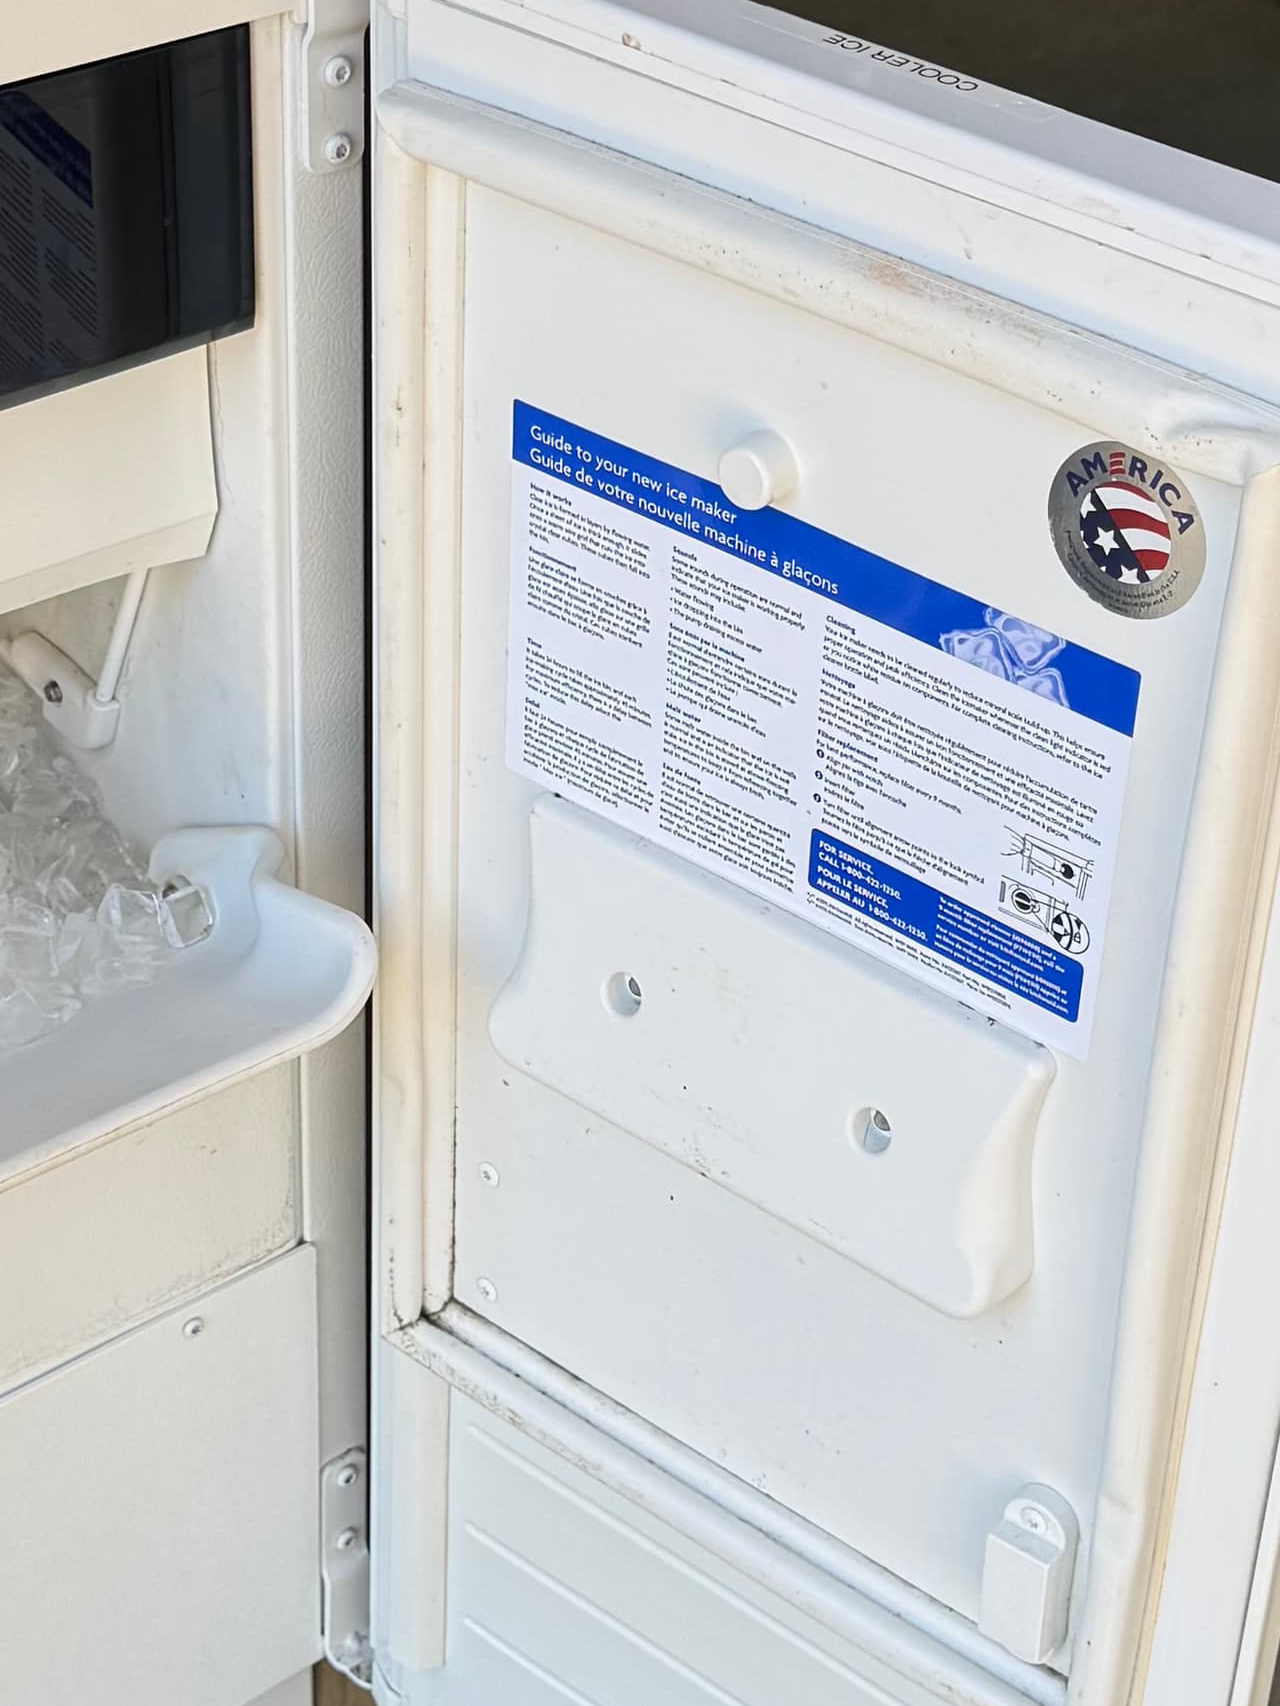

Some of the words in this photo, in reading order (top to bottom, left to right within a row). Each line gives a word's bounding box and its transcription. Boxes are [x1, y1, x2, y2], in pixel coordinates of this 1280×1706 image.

[822, 34, 871, 54] ICE
[872, 51, 978, 91] COOLER
[530, 425, 571, 454] Guide
[576, 446, 591, 462] to
[595, 456, 627, 476] your
[632, 472, 661, 491] new
[666, 482, 686, 503] ice
[691, 497, 736, 522] maker
[1065, 451, 1195, 535] AMERICA
[530, 448, 570, 476] Guide
[575, 468, 592, 485] de
[598, 480, 633, 503] votre
[638, 498, 699, 532] nouvelle
[704, 526, 765, 561] machine
[770, 551, 777, 567] à
[782, 560, 837, 593] glaçons
